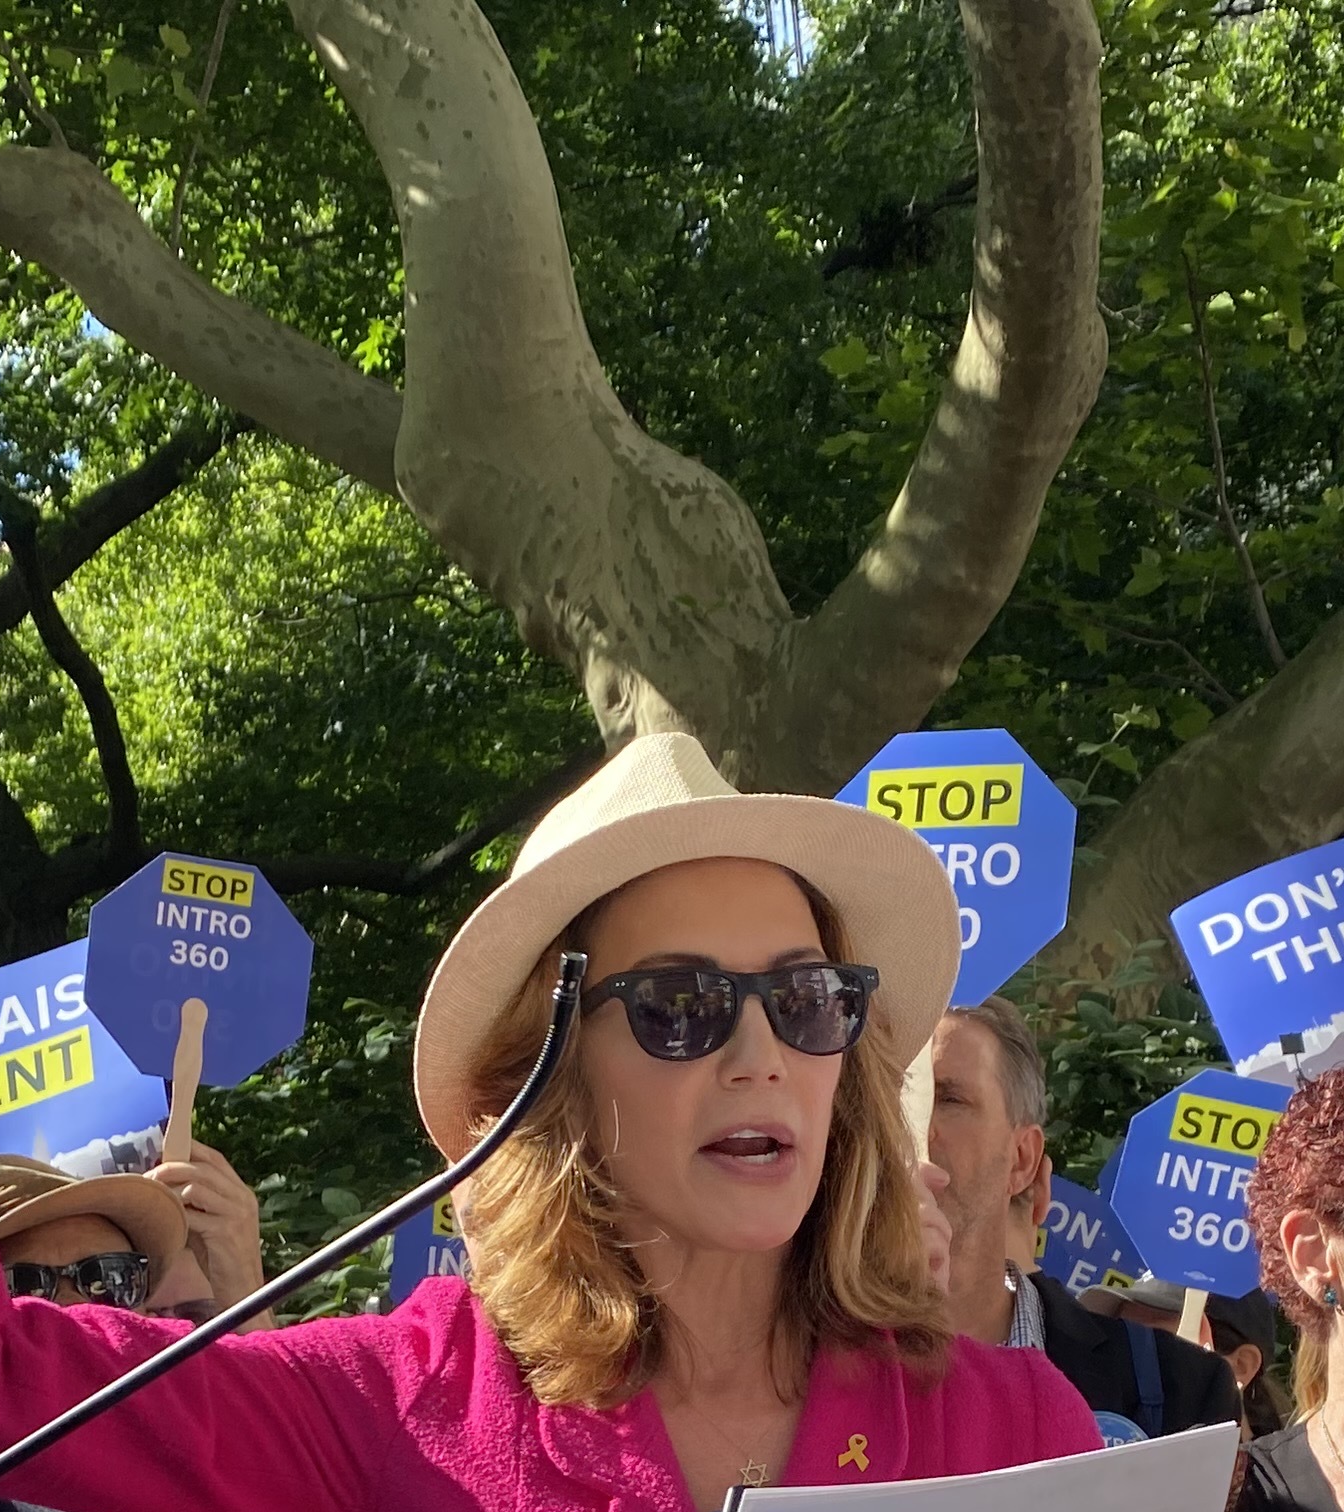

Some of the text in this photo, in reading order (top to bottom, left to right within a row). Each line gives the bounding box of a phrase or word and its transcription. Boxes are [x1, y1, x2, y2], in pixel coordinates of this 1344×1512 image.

[877, 779, 1013, 823] STOP
[166, 866, 251, 906] STOP
[156, 901, 252, 939] INTRO
[169, 940, 230, 972] 360
[1178, 1106, 1275, 1150] STO
[1168, 1206, 1251, 1252] 360
